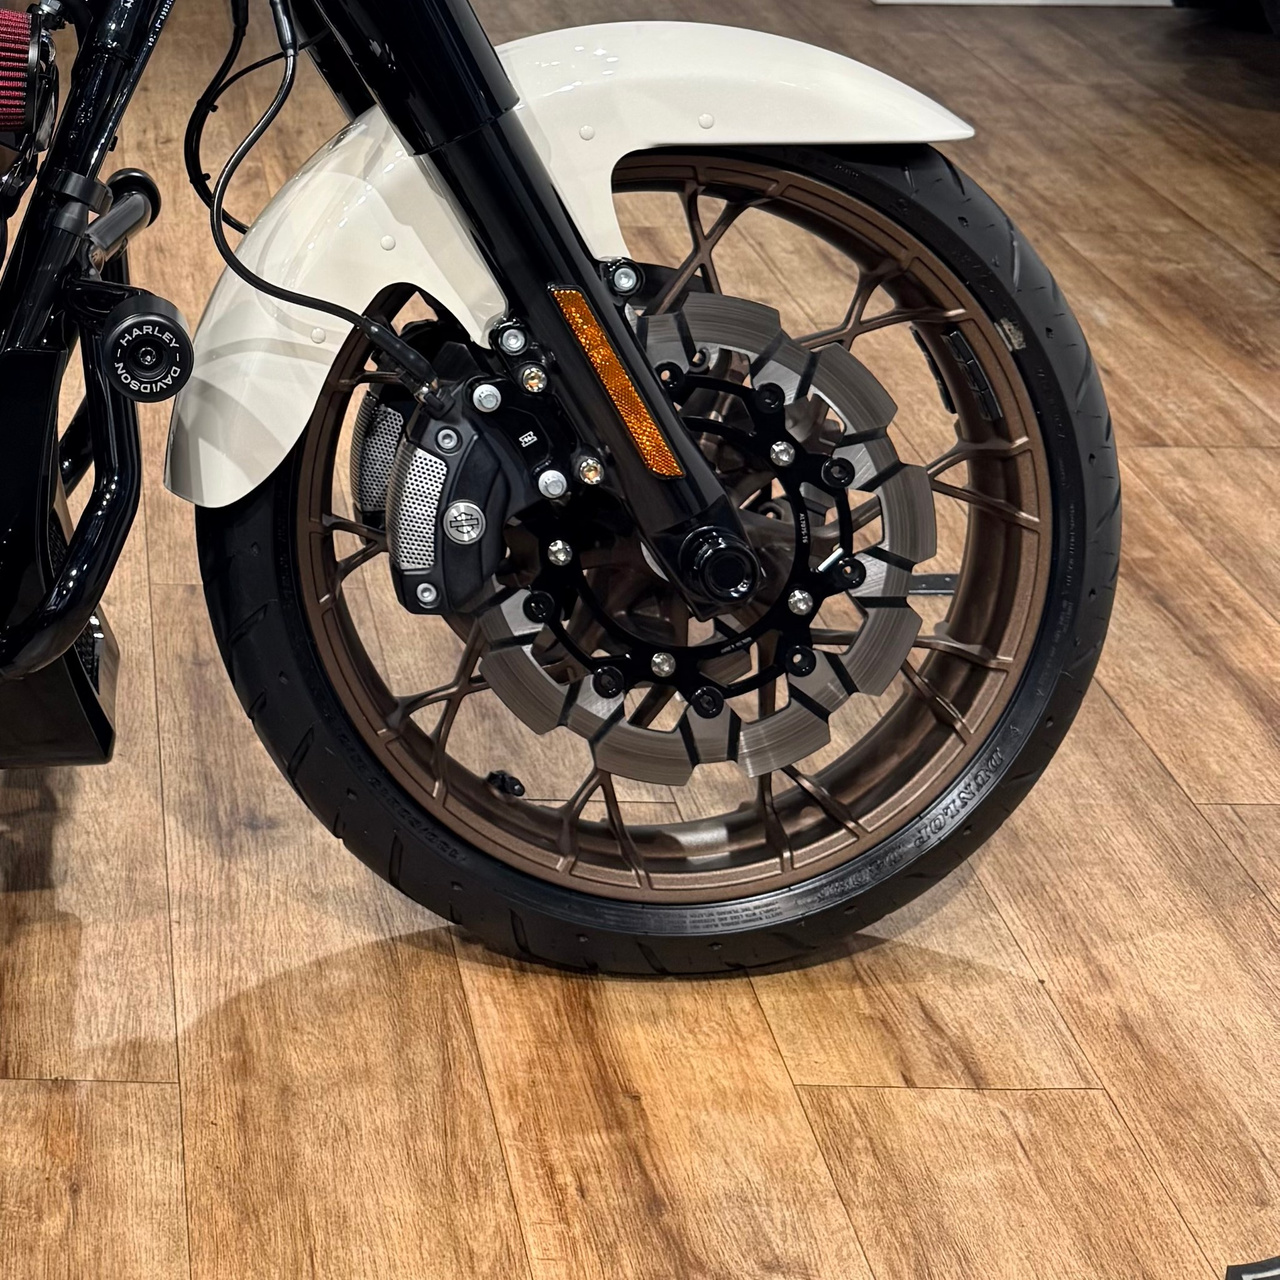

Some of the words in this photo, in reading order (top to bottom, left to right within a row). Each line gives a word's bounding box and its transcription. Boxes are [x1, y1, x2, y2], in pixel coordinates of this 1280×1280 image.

[119, 324, 180, 347] HARLEY
[114, 362, 181, 393] DAVIDSON
[913, 746, 1004, 848] DUNLOP
